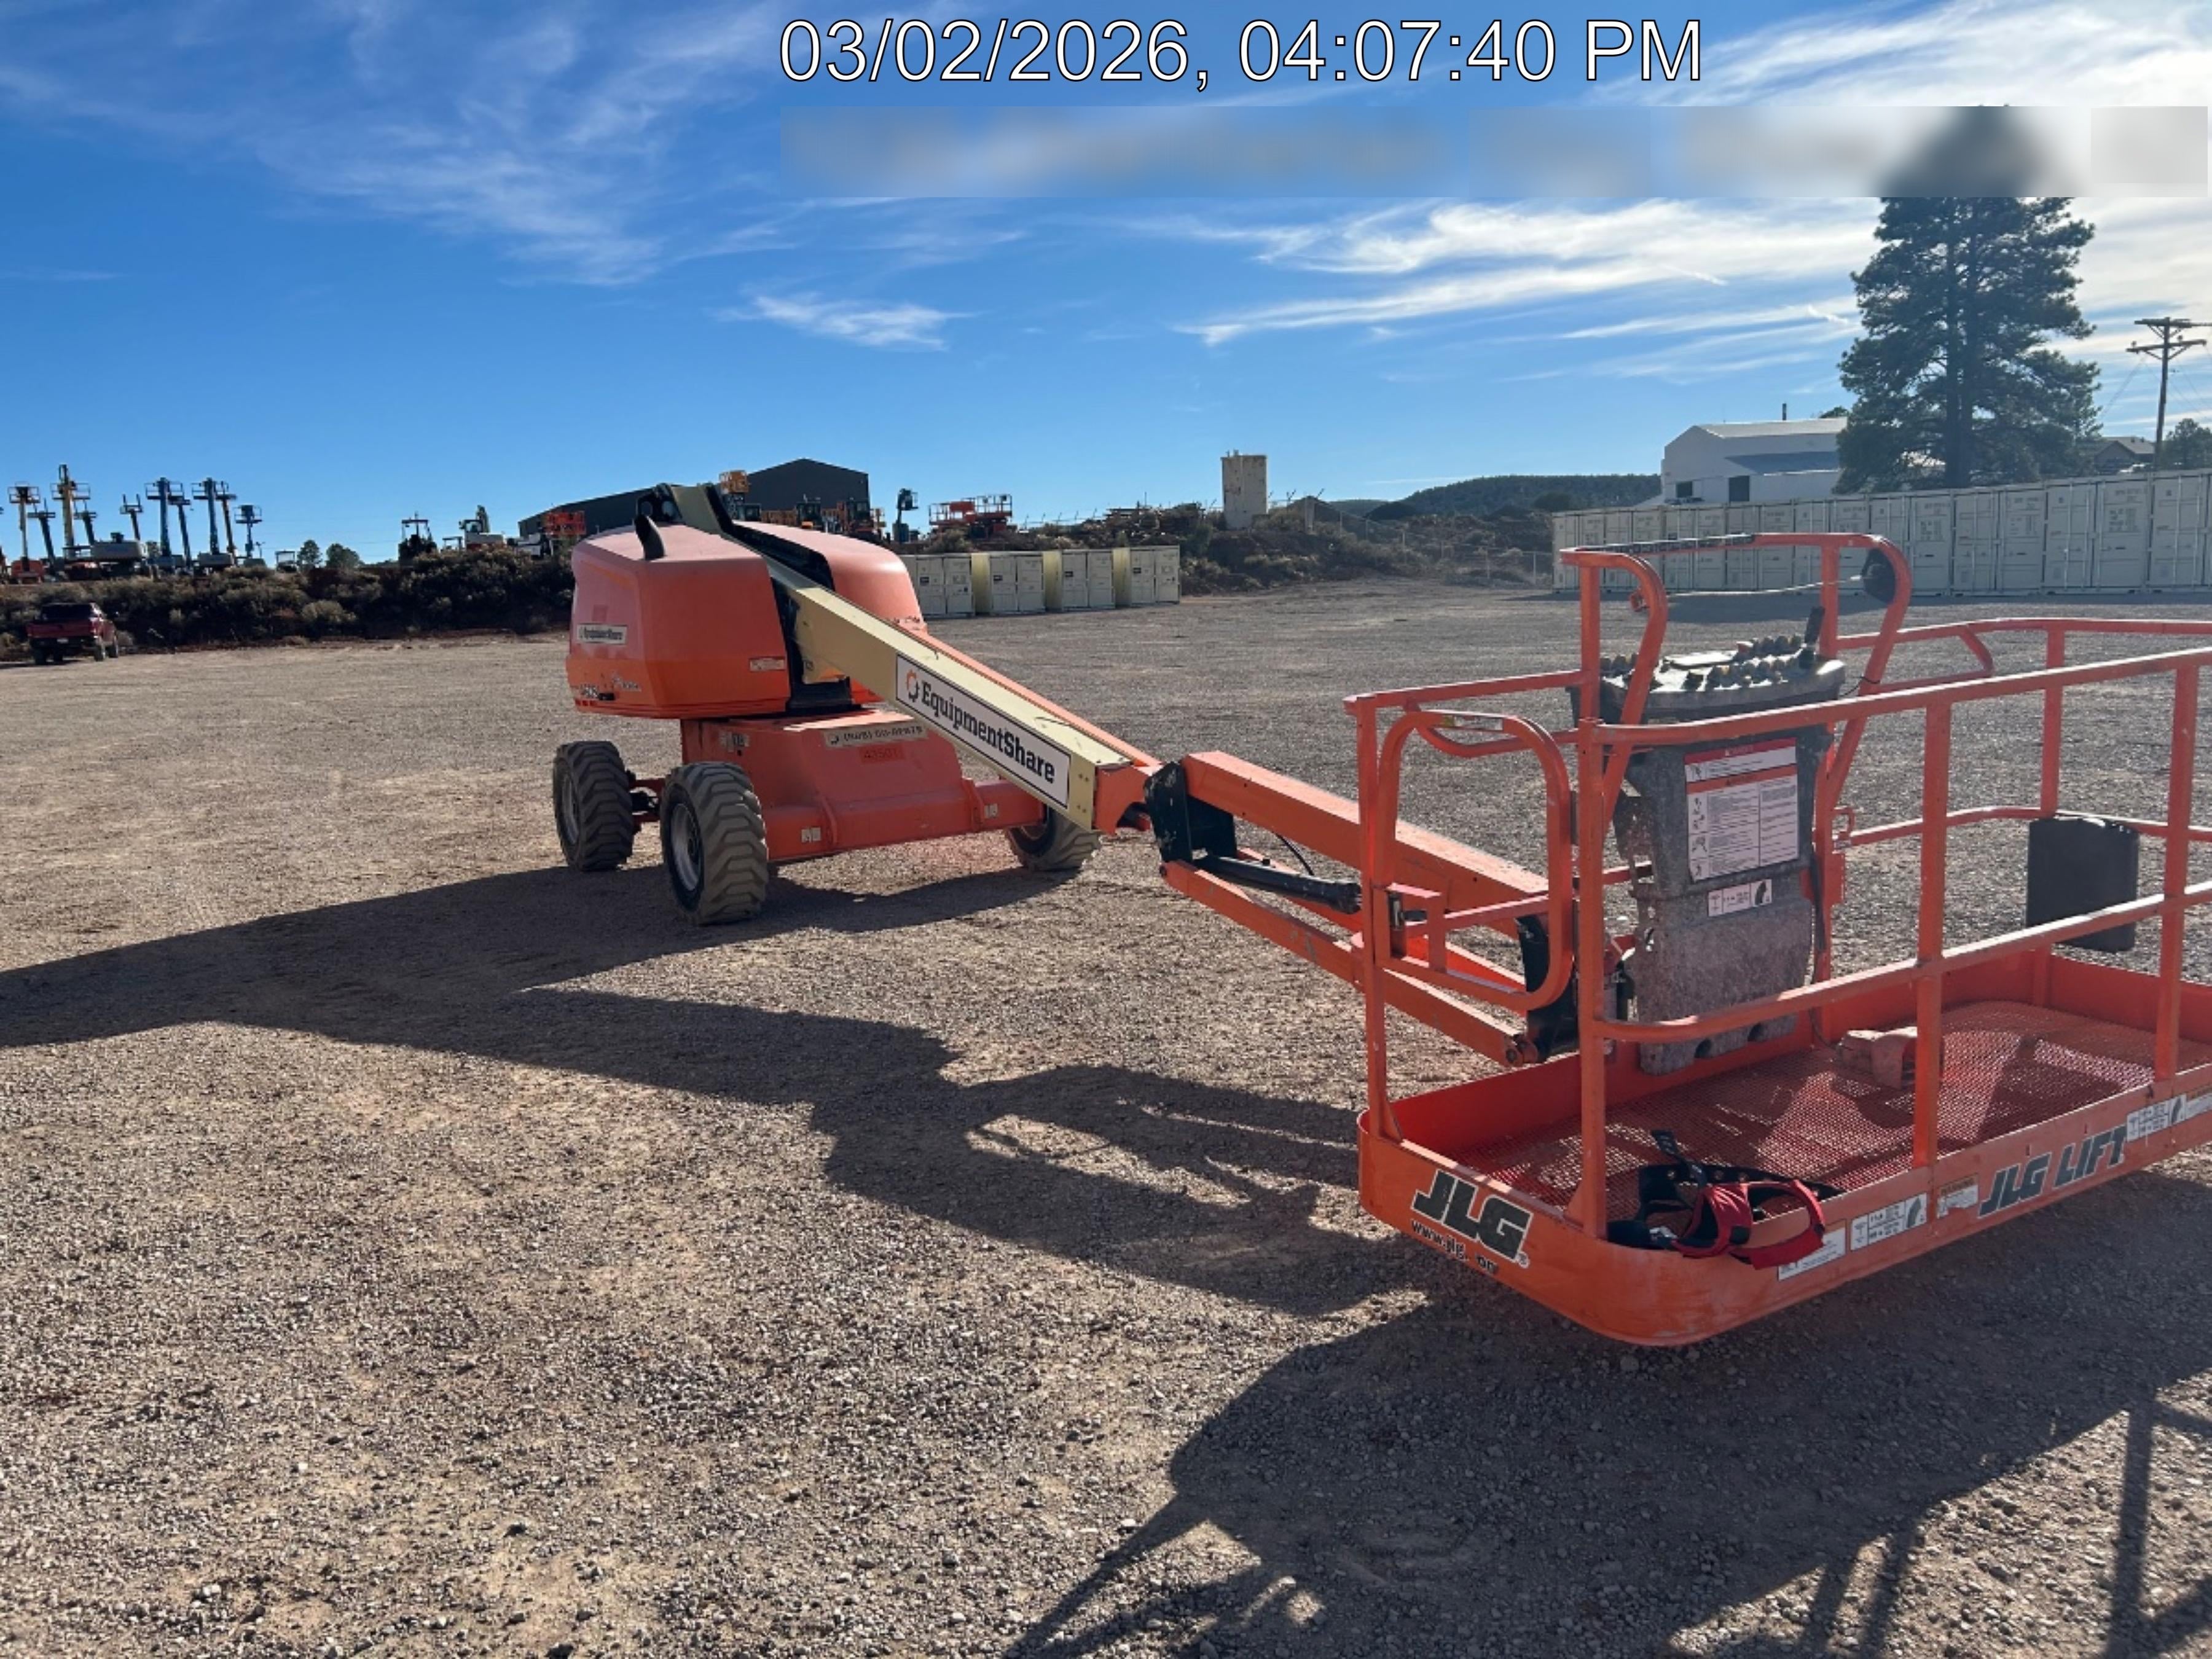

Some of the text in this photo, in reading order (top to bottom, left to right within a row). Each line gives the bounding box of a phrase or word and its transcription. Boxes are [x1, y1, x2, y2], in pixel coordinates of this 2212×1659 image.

[921, 678, 1056, 784] EquipmentShare
[1411, 1169, 1534, 1263] JLG
[1978, 1124, 2128, 1218] JLG LIFT
[1411, 1219, 1498, 1273] www.jlg.om
